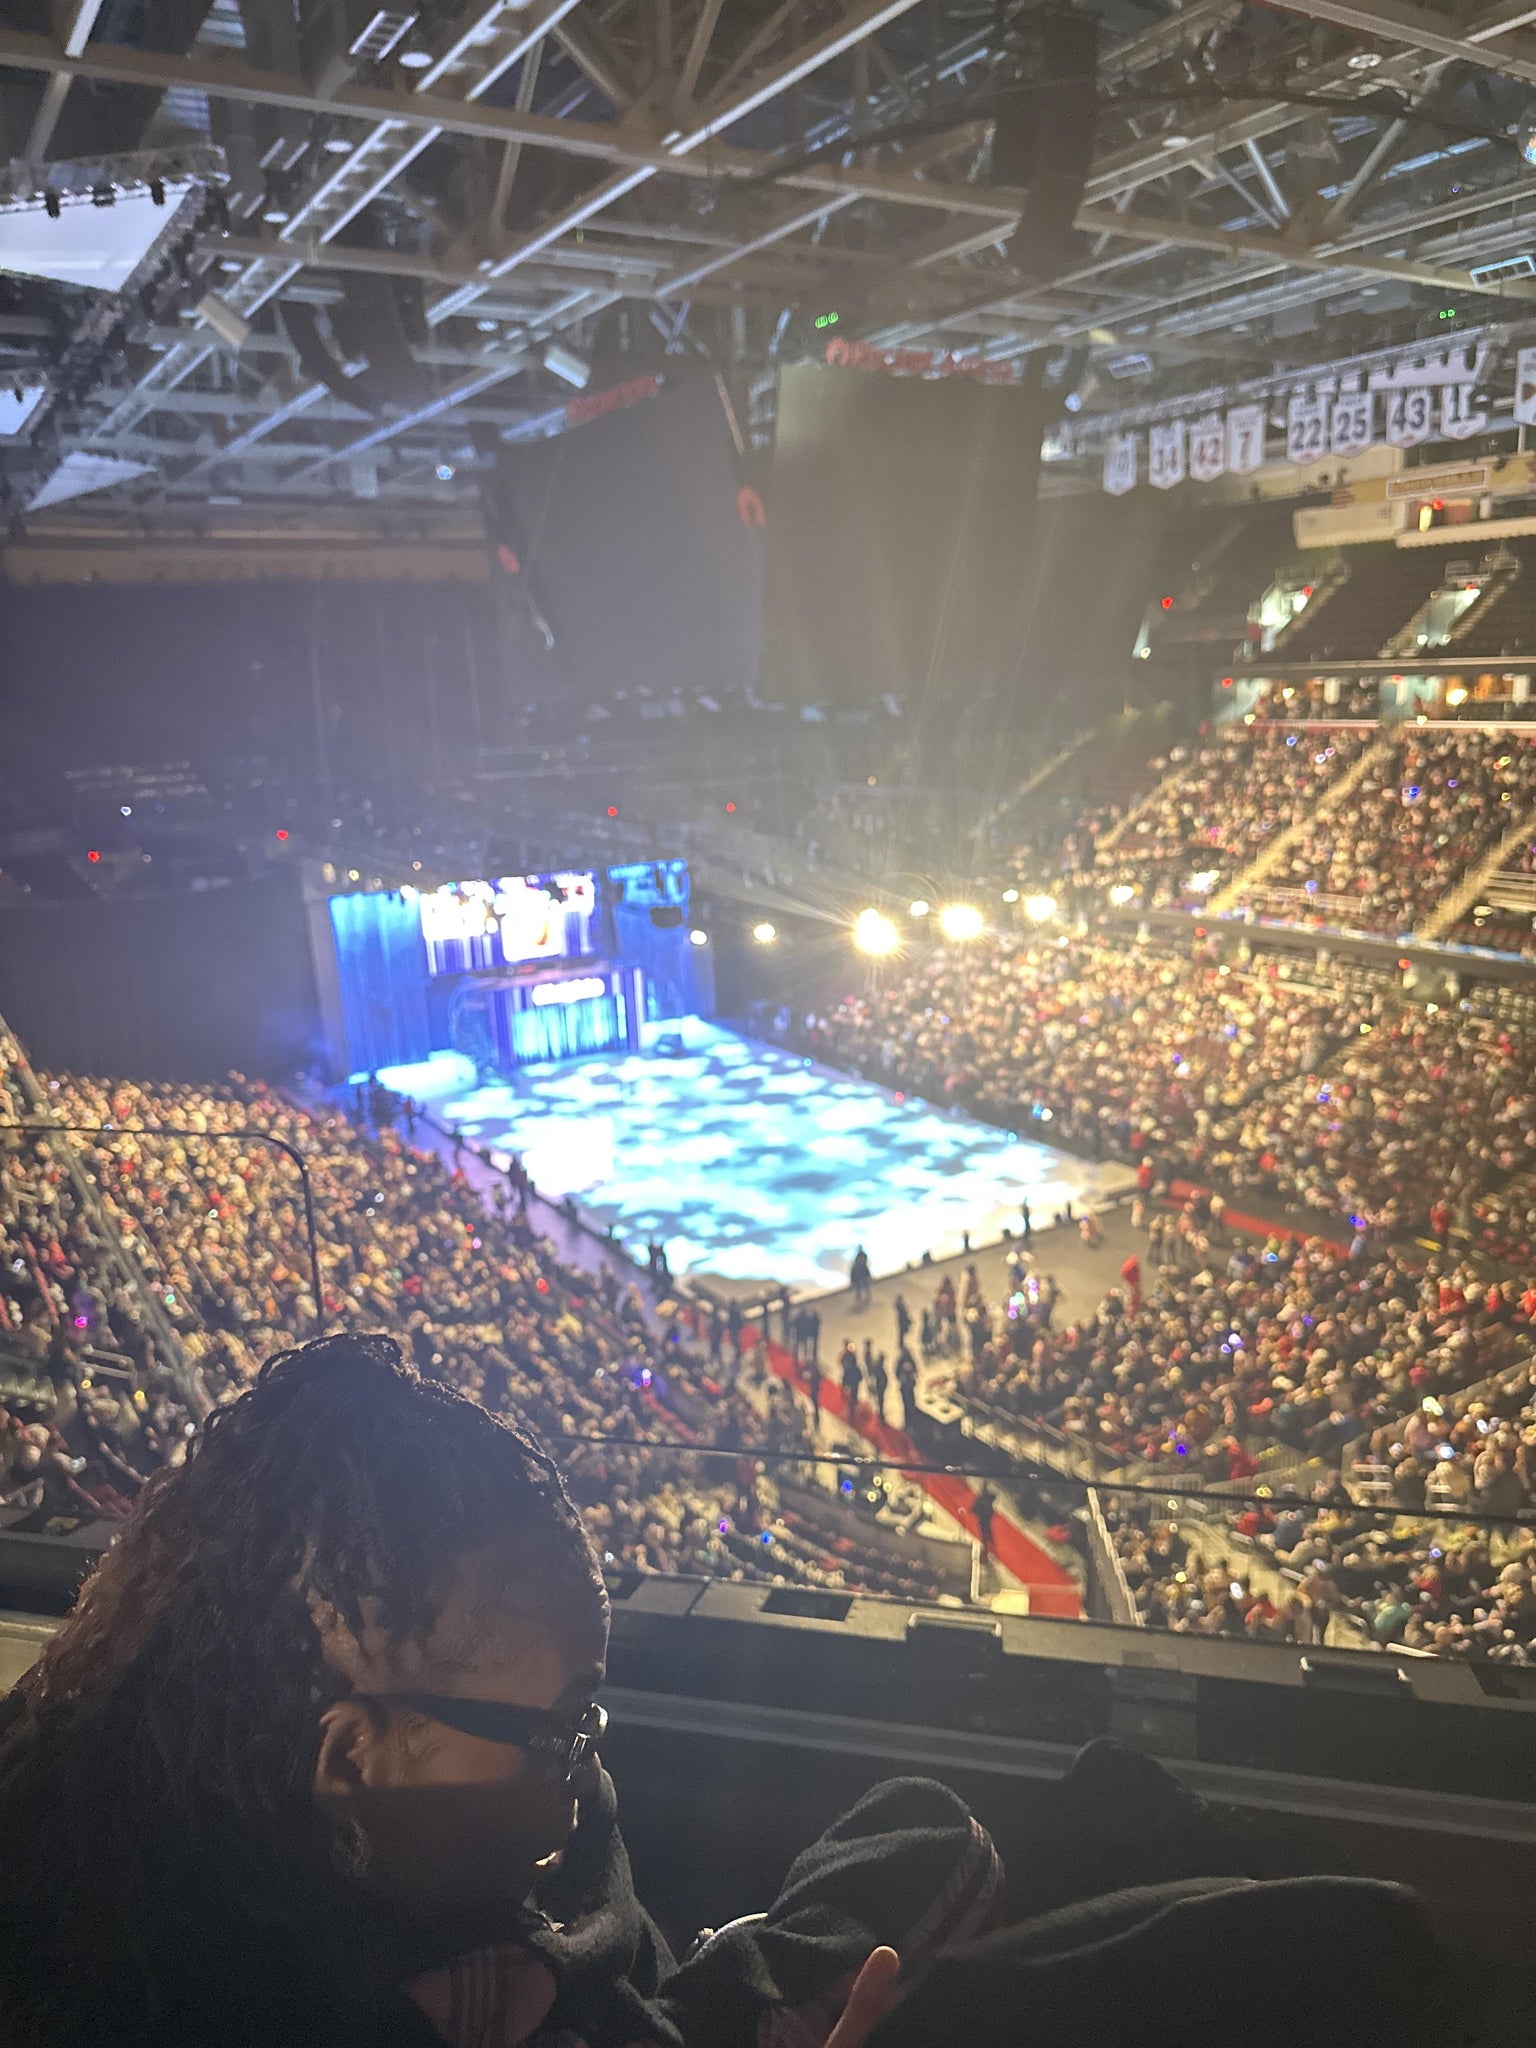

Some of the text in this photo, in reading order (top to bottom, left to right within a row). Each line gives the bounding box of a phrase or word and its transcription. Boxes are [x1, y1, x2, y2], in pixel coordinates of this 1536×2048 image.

[1336, 407, 1367, 441] 25
[1392, 388, 1425, 432] 43
[1238, 430, 1250, 467] 7
[1292, 417, 1321, 451] 22
